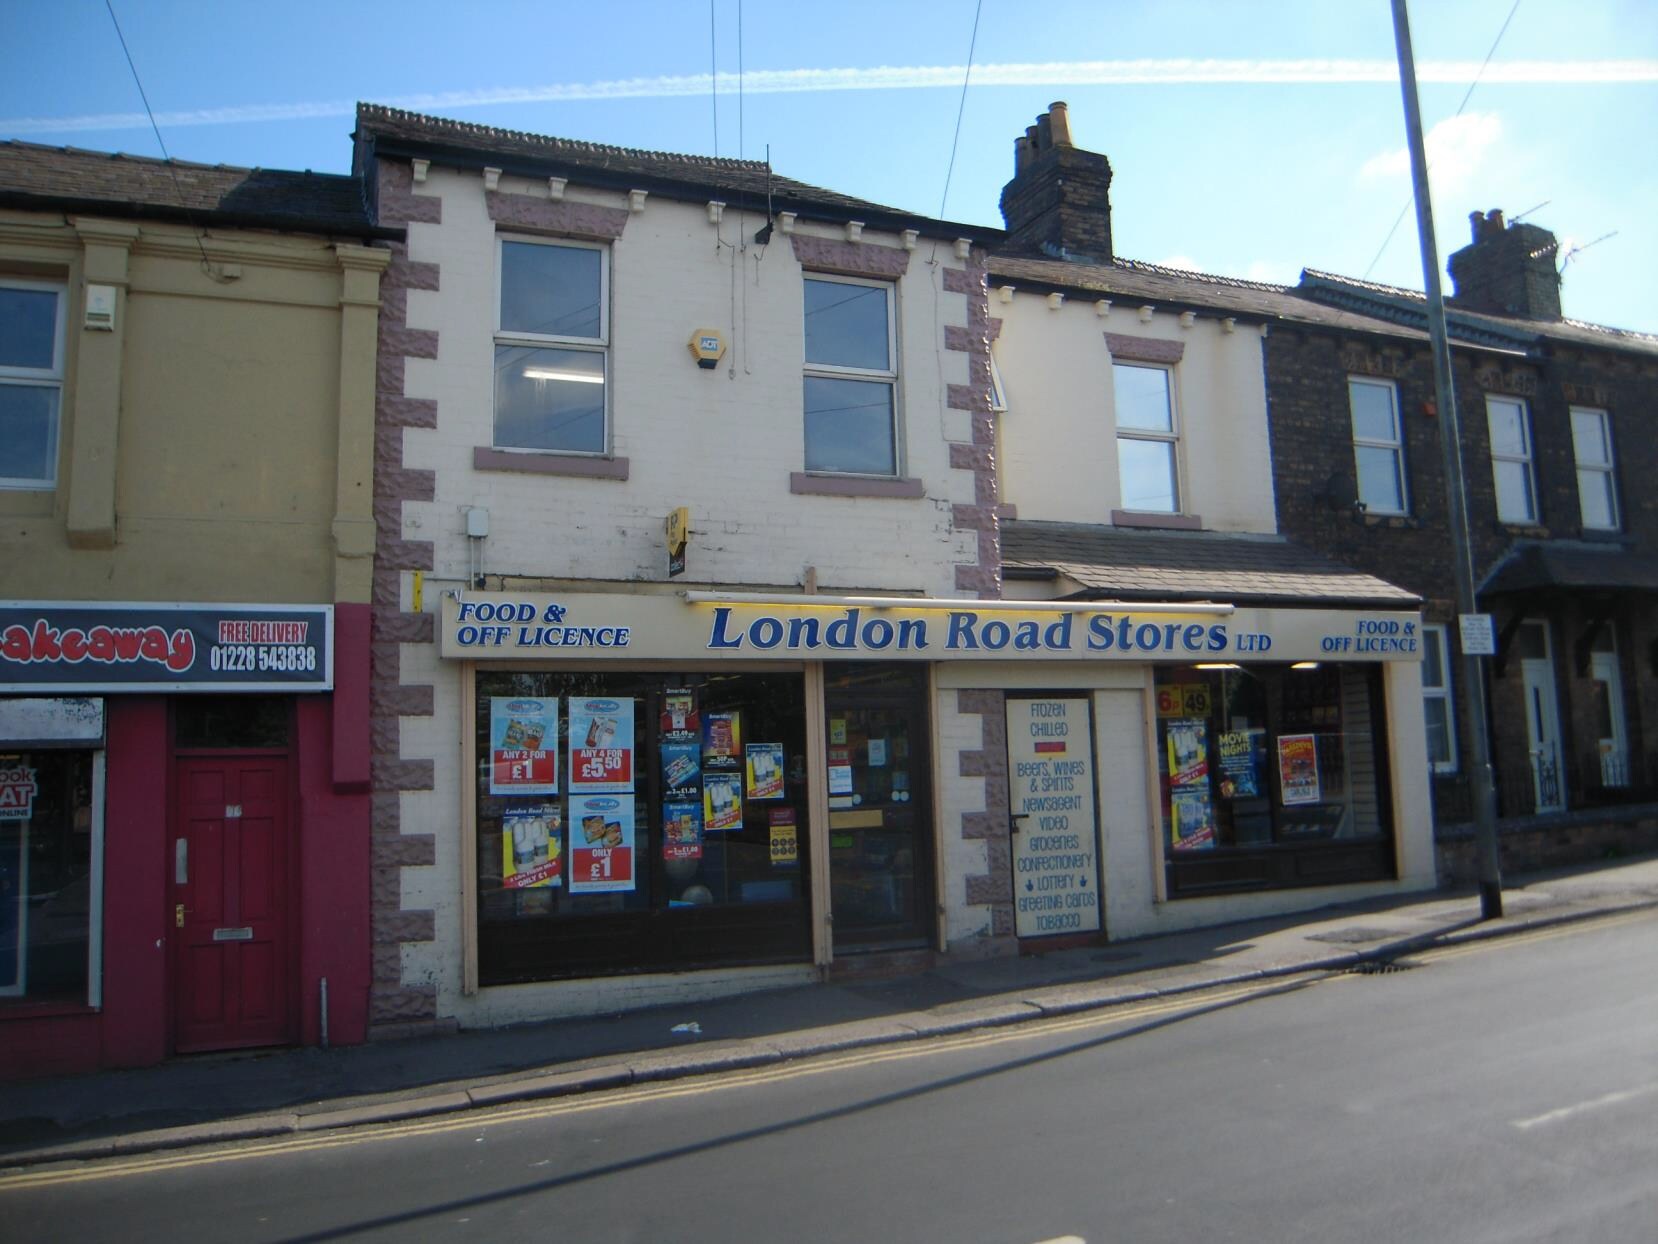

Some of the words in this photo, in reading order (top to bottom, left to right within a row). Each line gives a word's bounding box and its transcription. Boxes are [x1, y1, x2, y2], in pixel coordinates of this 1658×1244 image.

[457, 602, 536, 623] FOOD
[542, 604, 567, 624] &
[219, 621, 249, 644] FREE
[250, 621, 308, 644] DELIVERY
[457, 626, 511, 646] OFF
[516, 626, 630, 647] LICENCE
[707, 607, 929, 650] London
[945, 611, 1073, 650] Road
[1087, 613, 1228, 651] Stores
[1235, 633, 1272, 651] LTD
[1357, 620, 1400, 634] FOOD
[1403, 621, 1416, 634] &
[0, 619, 195, 672] akeaway
[1321, 637, 1352, 651] OFF
[1355, 637, 1417, 651] LICENCE
[210, 646, 256, 670] 01228
[258, 646, 316, 670] 543838
[503, 751, 521, 759] ANY
[522, 751, 528, 759] 2
[530, 751, 546, 759] FOR
[580, 750, 597, 758] ANY
[607, 750, 622, 758] FOR
[512, 759, 533, 778] £1
[1030, 778, 1038, 792] &
[592, 849, 612, 857] ONLY
[591, 857, 611, 877] £1
